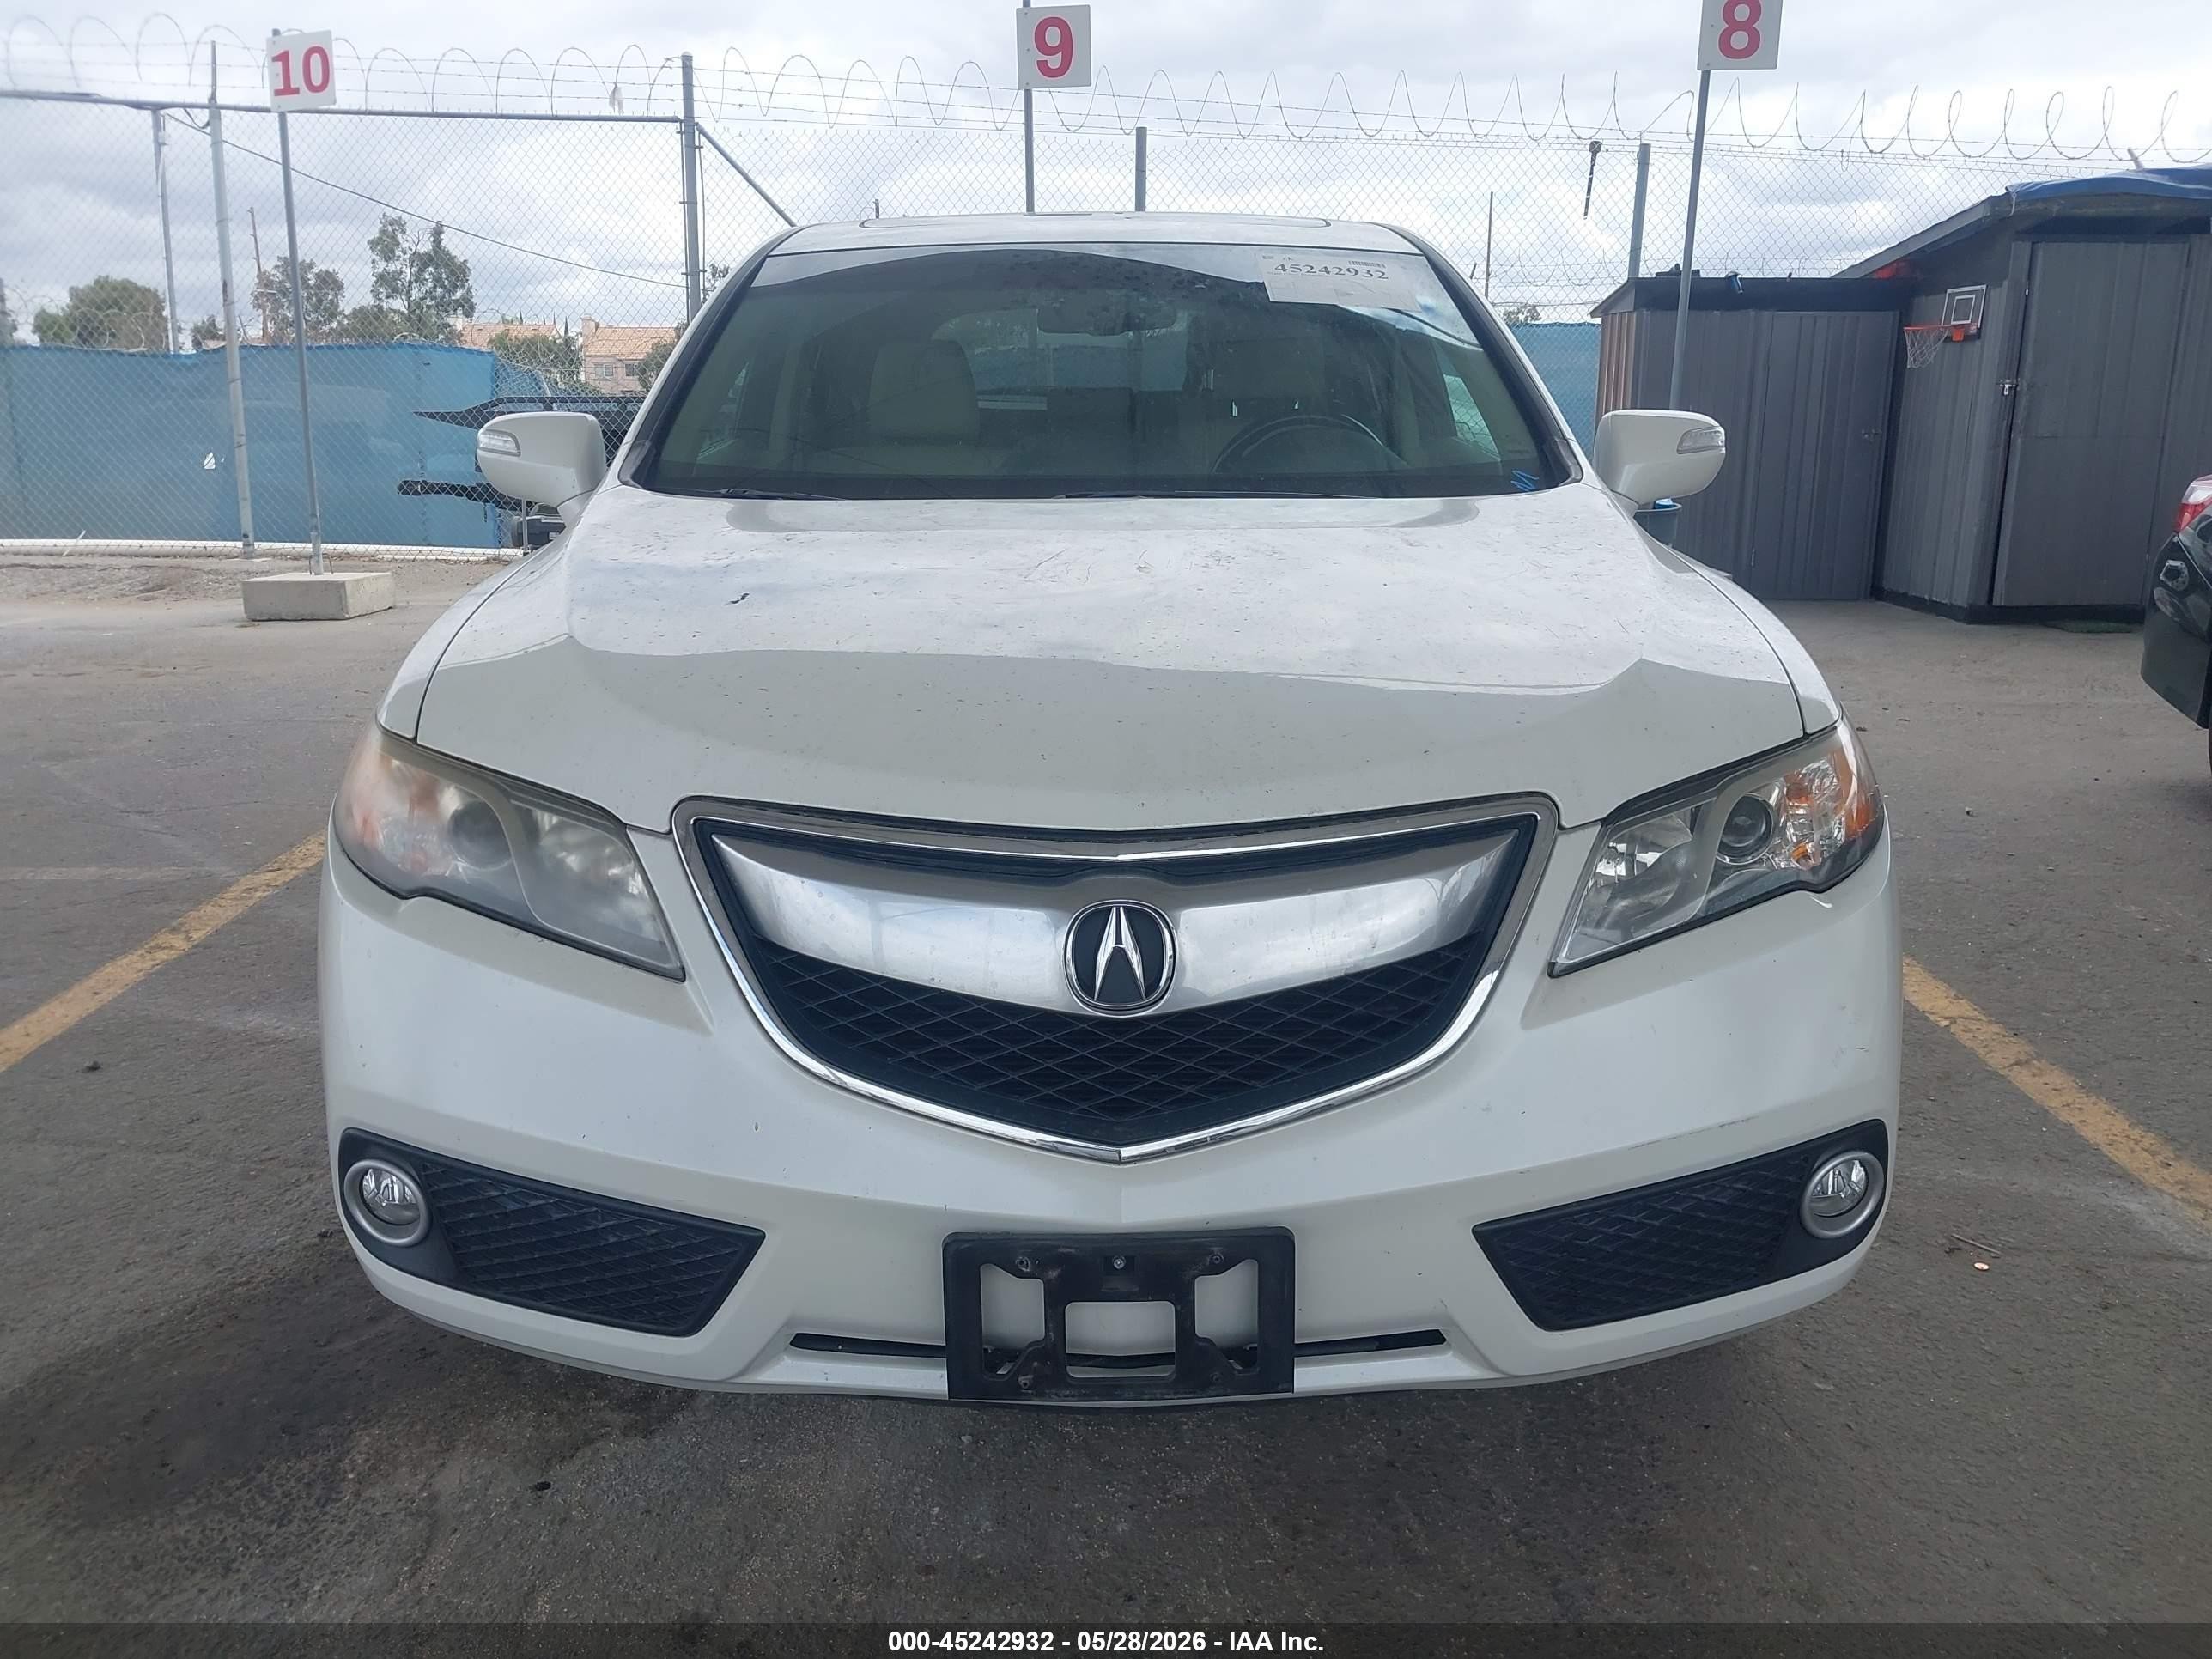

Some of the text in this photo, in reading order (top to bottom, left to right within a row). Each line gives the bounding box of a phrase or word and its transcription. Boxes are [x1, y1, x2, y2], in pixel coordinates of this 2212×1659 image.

[1034, 16, 1073, 78] 9
[1718, 0, 1761, 59] 8
[271, 46, 330, 96] 10
[1274, 263, 1389, 280] 45242932
